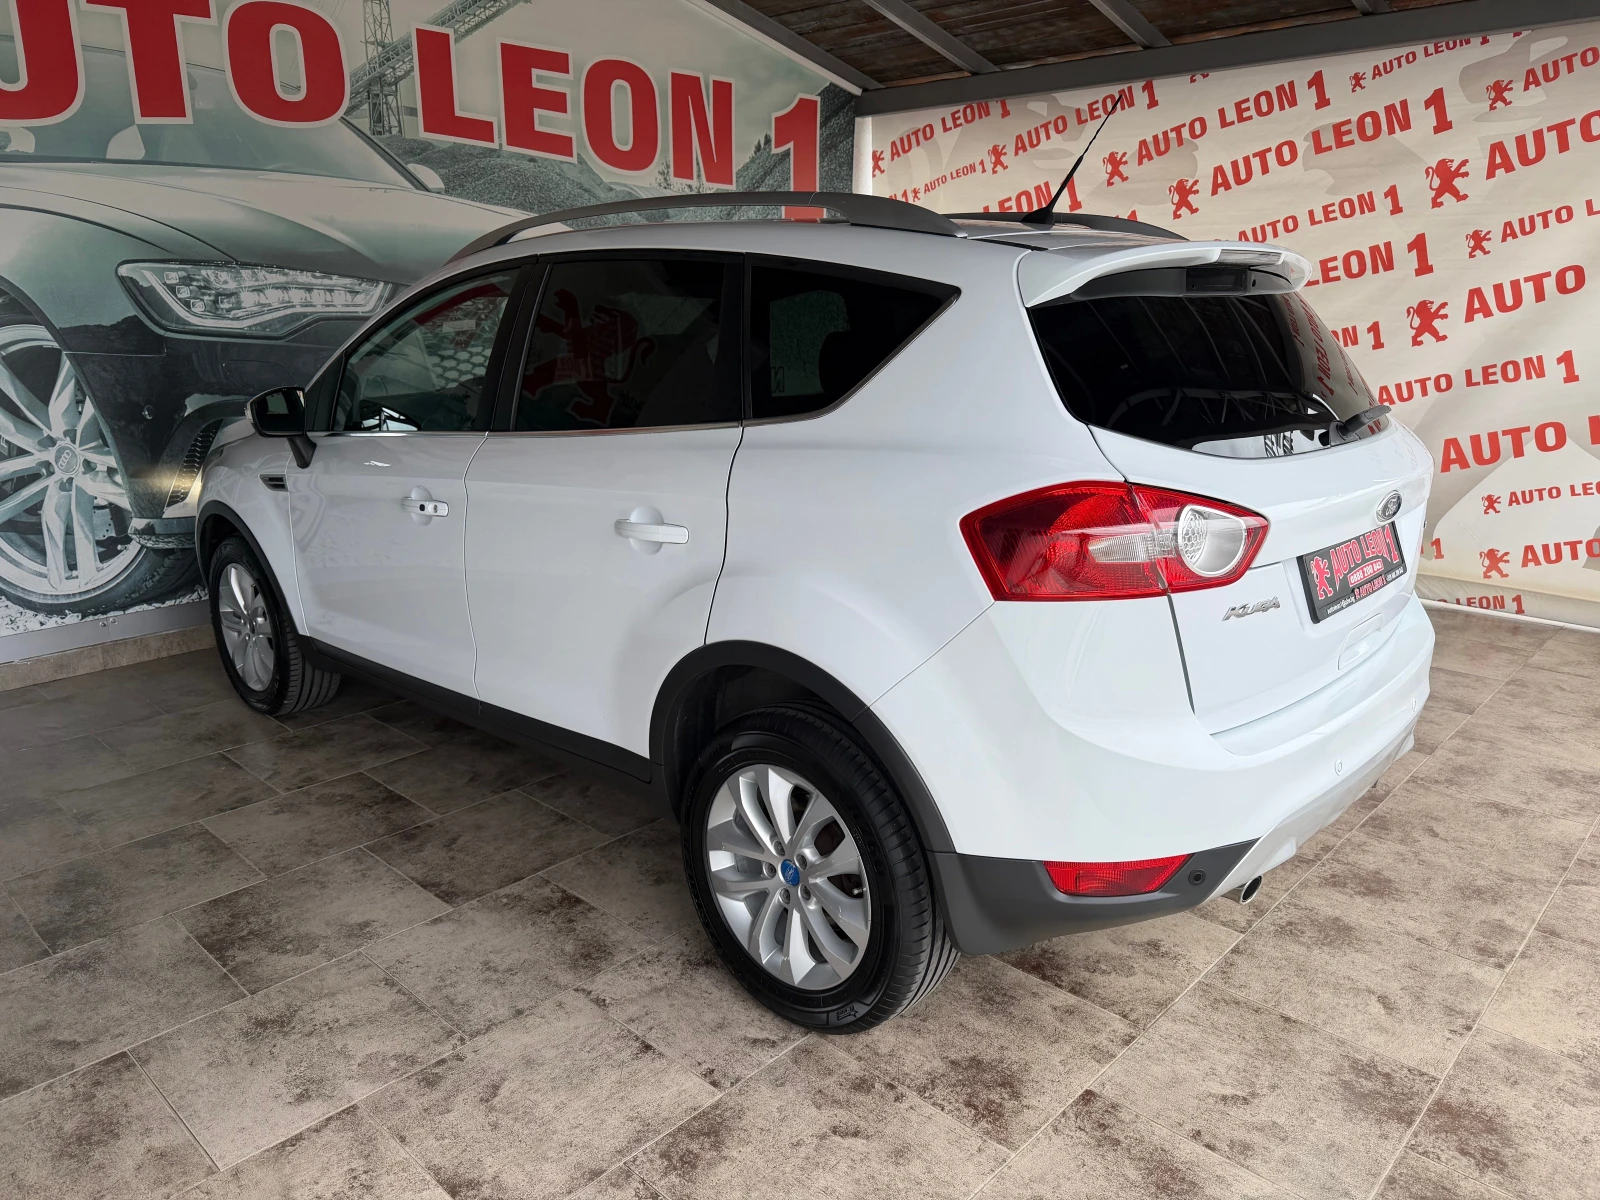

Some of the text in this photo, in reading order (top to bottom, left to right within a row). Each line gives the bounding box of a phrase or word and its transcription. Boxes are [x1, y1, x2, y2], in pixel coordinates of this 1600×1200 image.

[1372, 51, 1418, 81] AUTO
[1522, 46, 1600, 92] AUTO
[414, 26, 735, 188] LEON
[772, 96, 825, 223] 1
[890, 98, 1012, 162] AUTO LEON 1
[1013, 79, 1160, 157] AUTO LEON 1
[1136, 69, 1331, 167] AUTO LEON 1
[1210, 87, 1454, 197] AUTO LEON 1
[1485, 109, 1600, 181] AUTO
[923, 158, 987, 195] AUTO LEON 1
[1058, 176, 1083, 213] 1
[1237, 183, 1405, 244] AUTO LEON 1
[1500, 204, 1575, 244] AUTO
[1406, 232, 1435, 278] 1
[1463, 264, 1587, 324] AUTO
[1366, 320, 1386, 351] 1
[1377, 349, 1581, 407] AUTO LEON 1
[1439, 420, 1568, 474] AUTO
[1507, 485, 1562, 507] AUTO
[1330, 523, 1400, 592] AUTO LEON 1
[1429, 537, 1445, 561] 1
[1521, 537, 1600, 569] AUTO
[1511, 593, 1526, 615] 1
